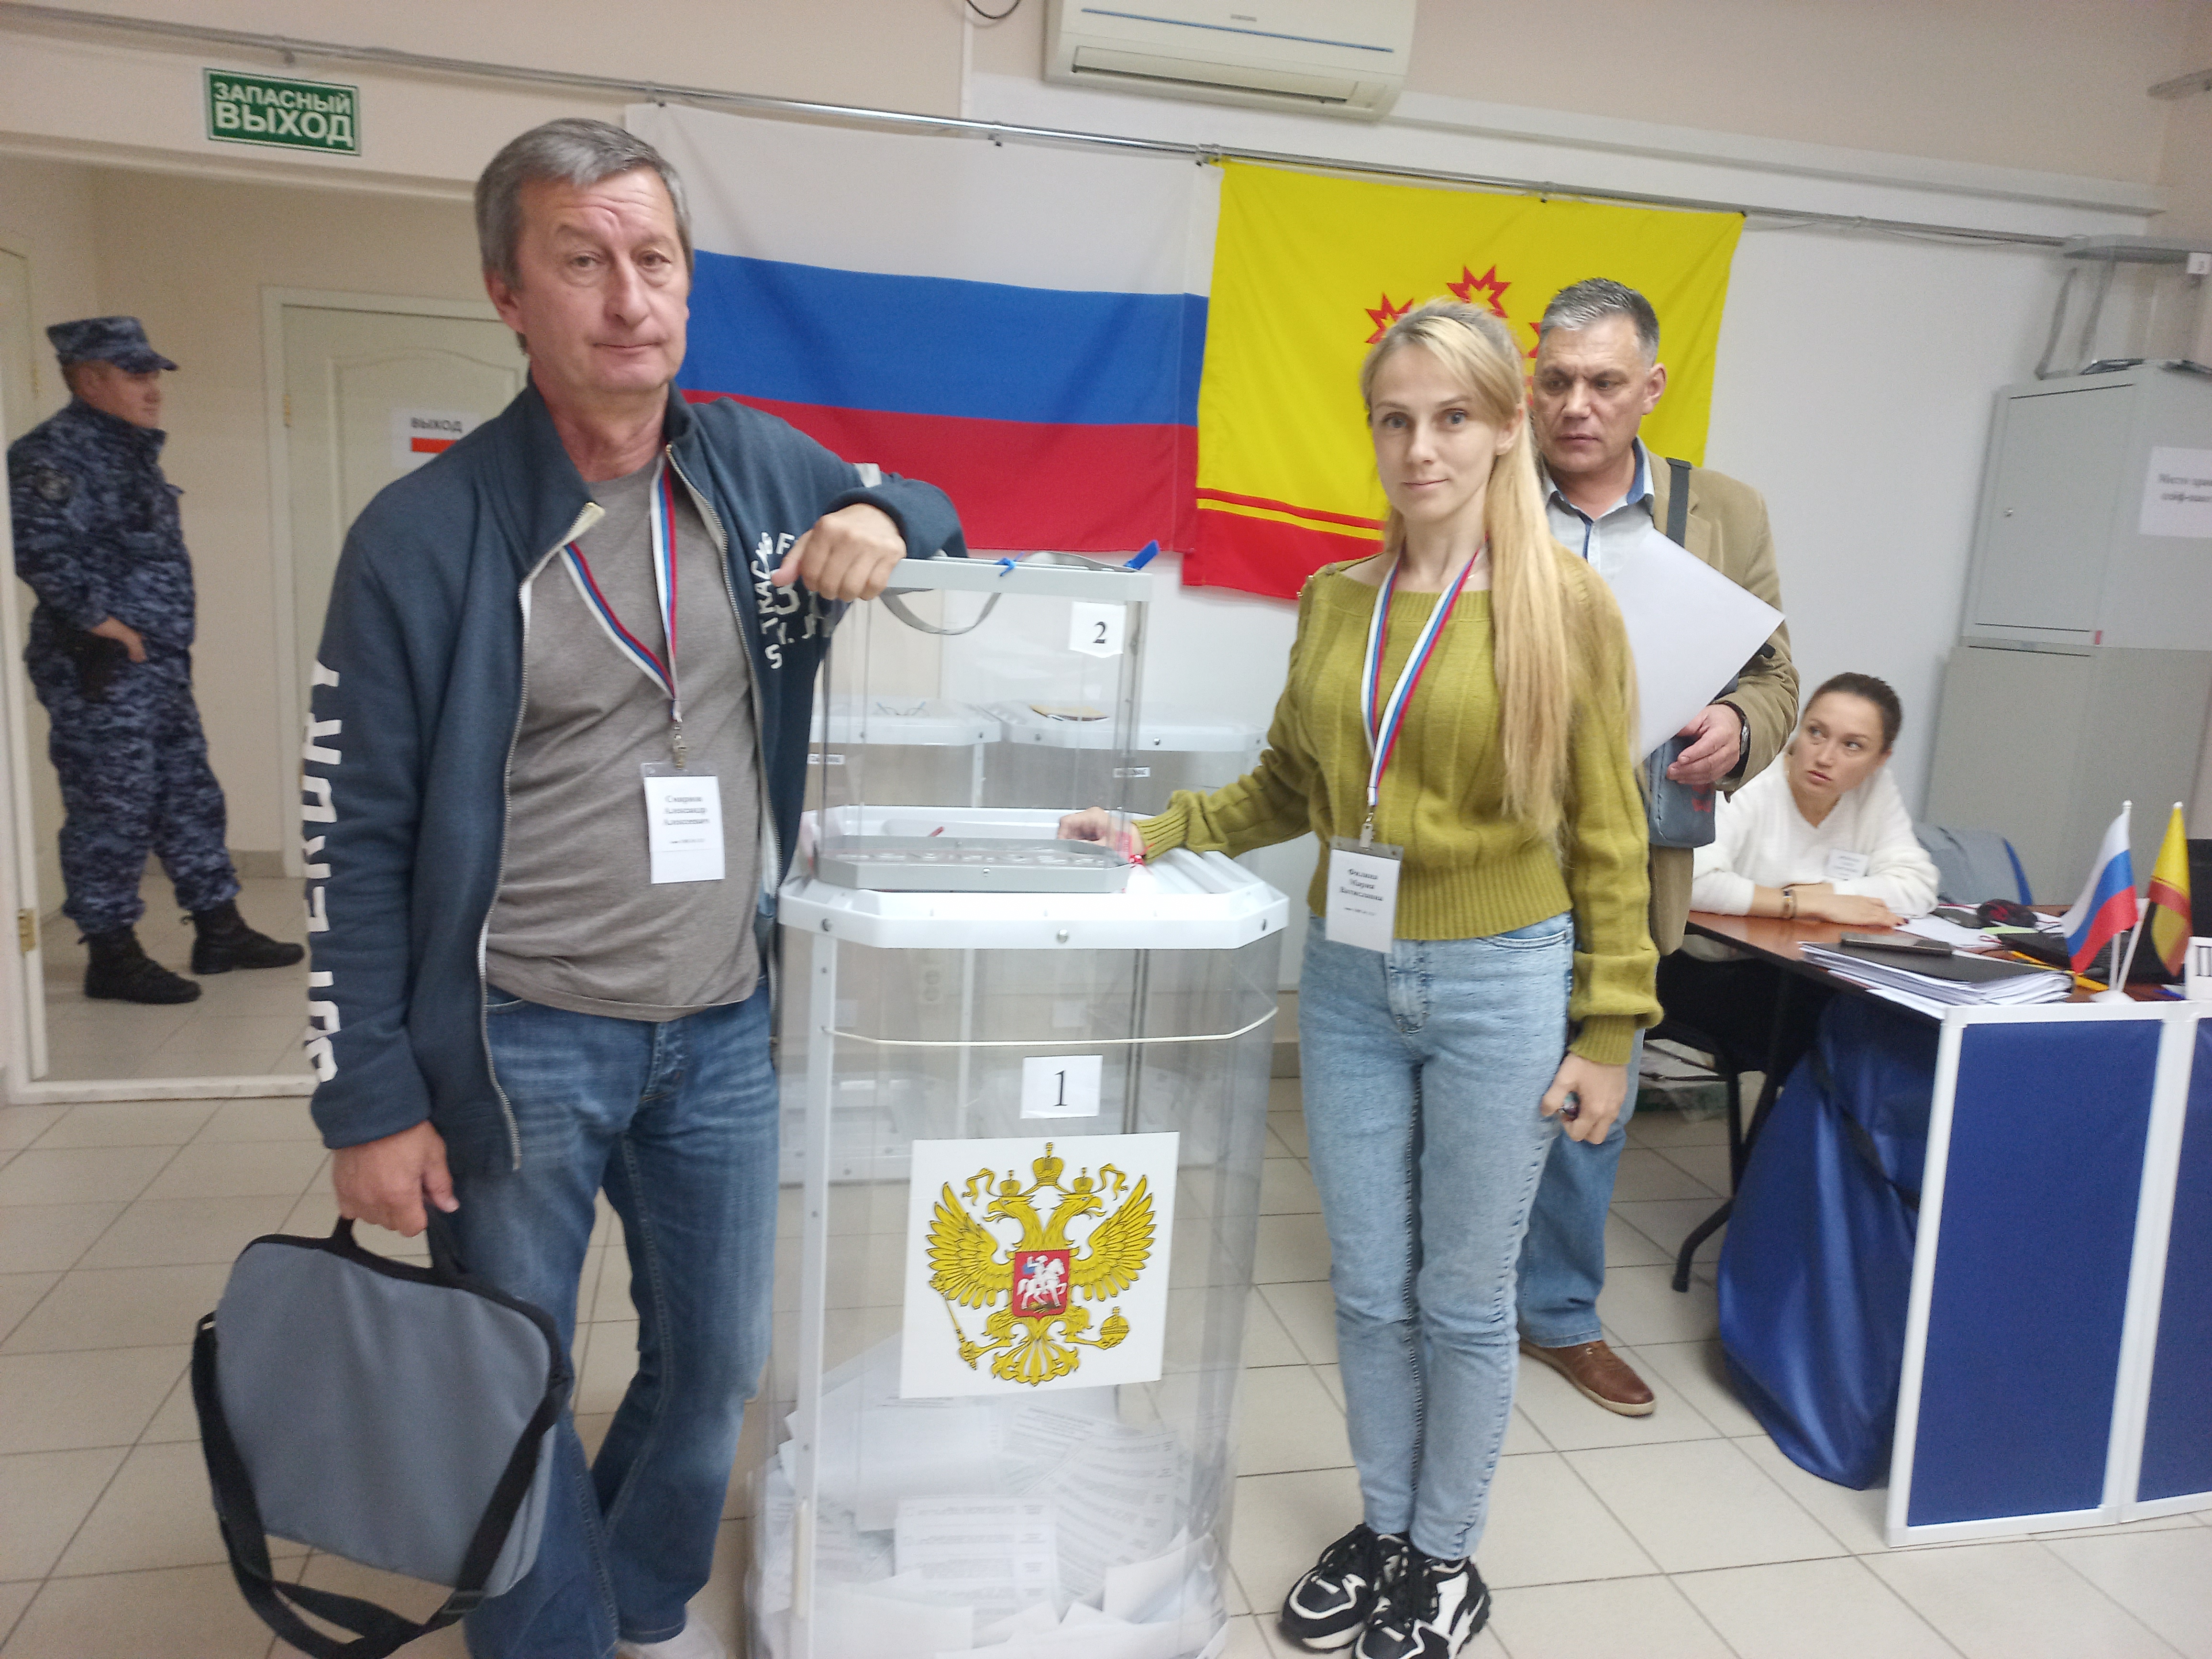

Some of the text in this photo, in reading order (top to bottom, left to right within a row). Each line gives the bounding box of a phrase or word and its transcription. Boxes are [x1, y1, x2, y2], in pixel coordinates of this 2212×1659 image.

[214, 82, 352, 114] ЗАПАСНЫЙ
[215, 101, 354, 147] ВЫХОД
[1092, 621, 1106, 644] 2
[1053, 1070, 1068, 1106] 1
